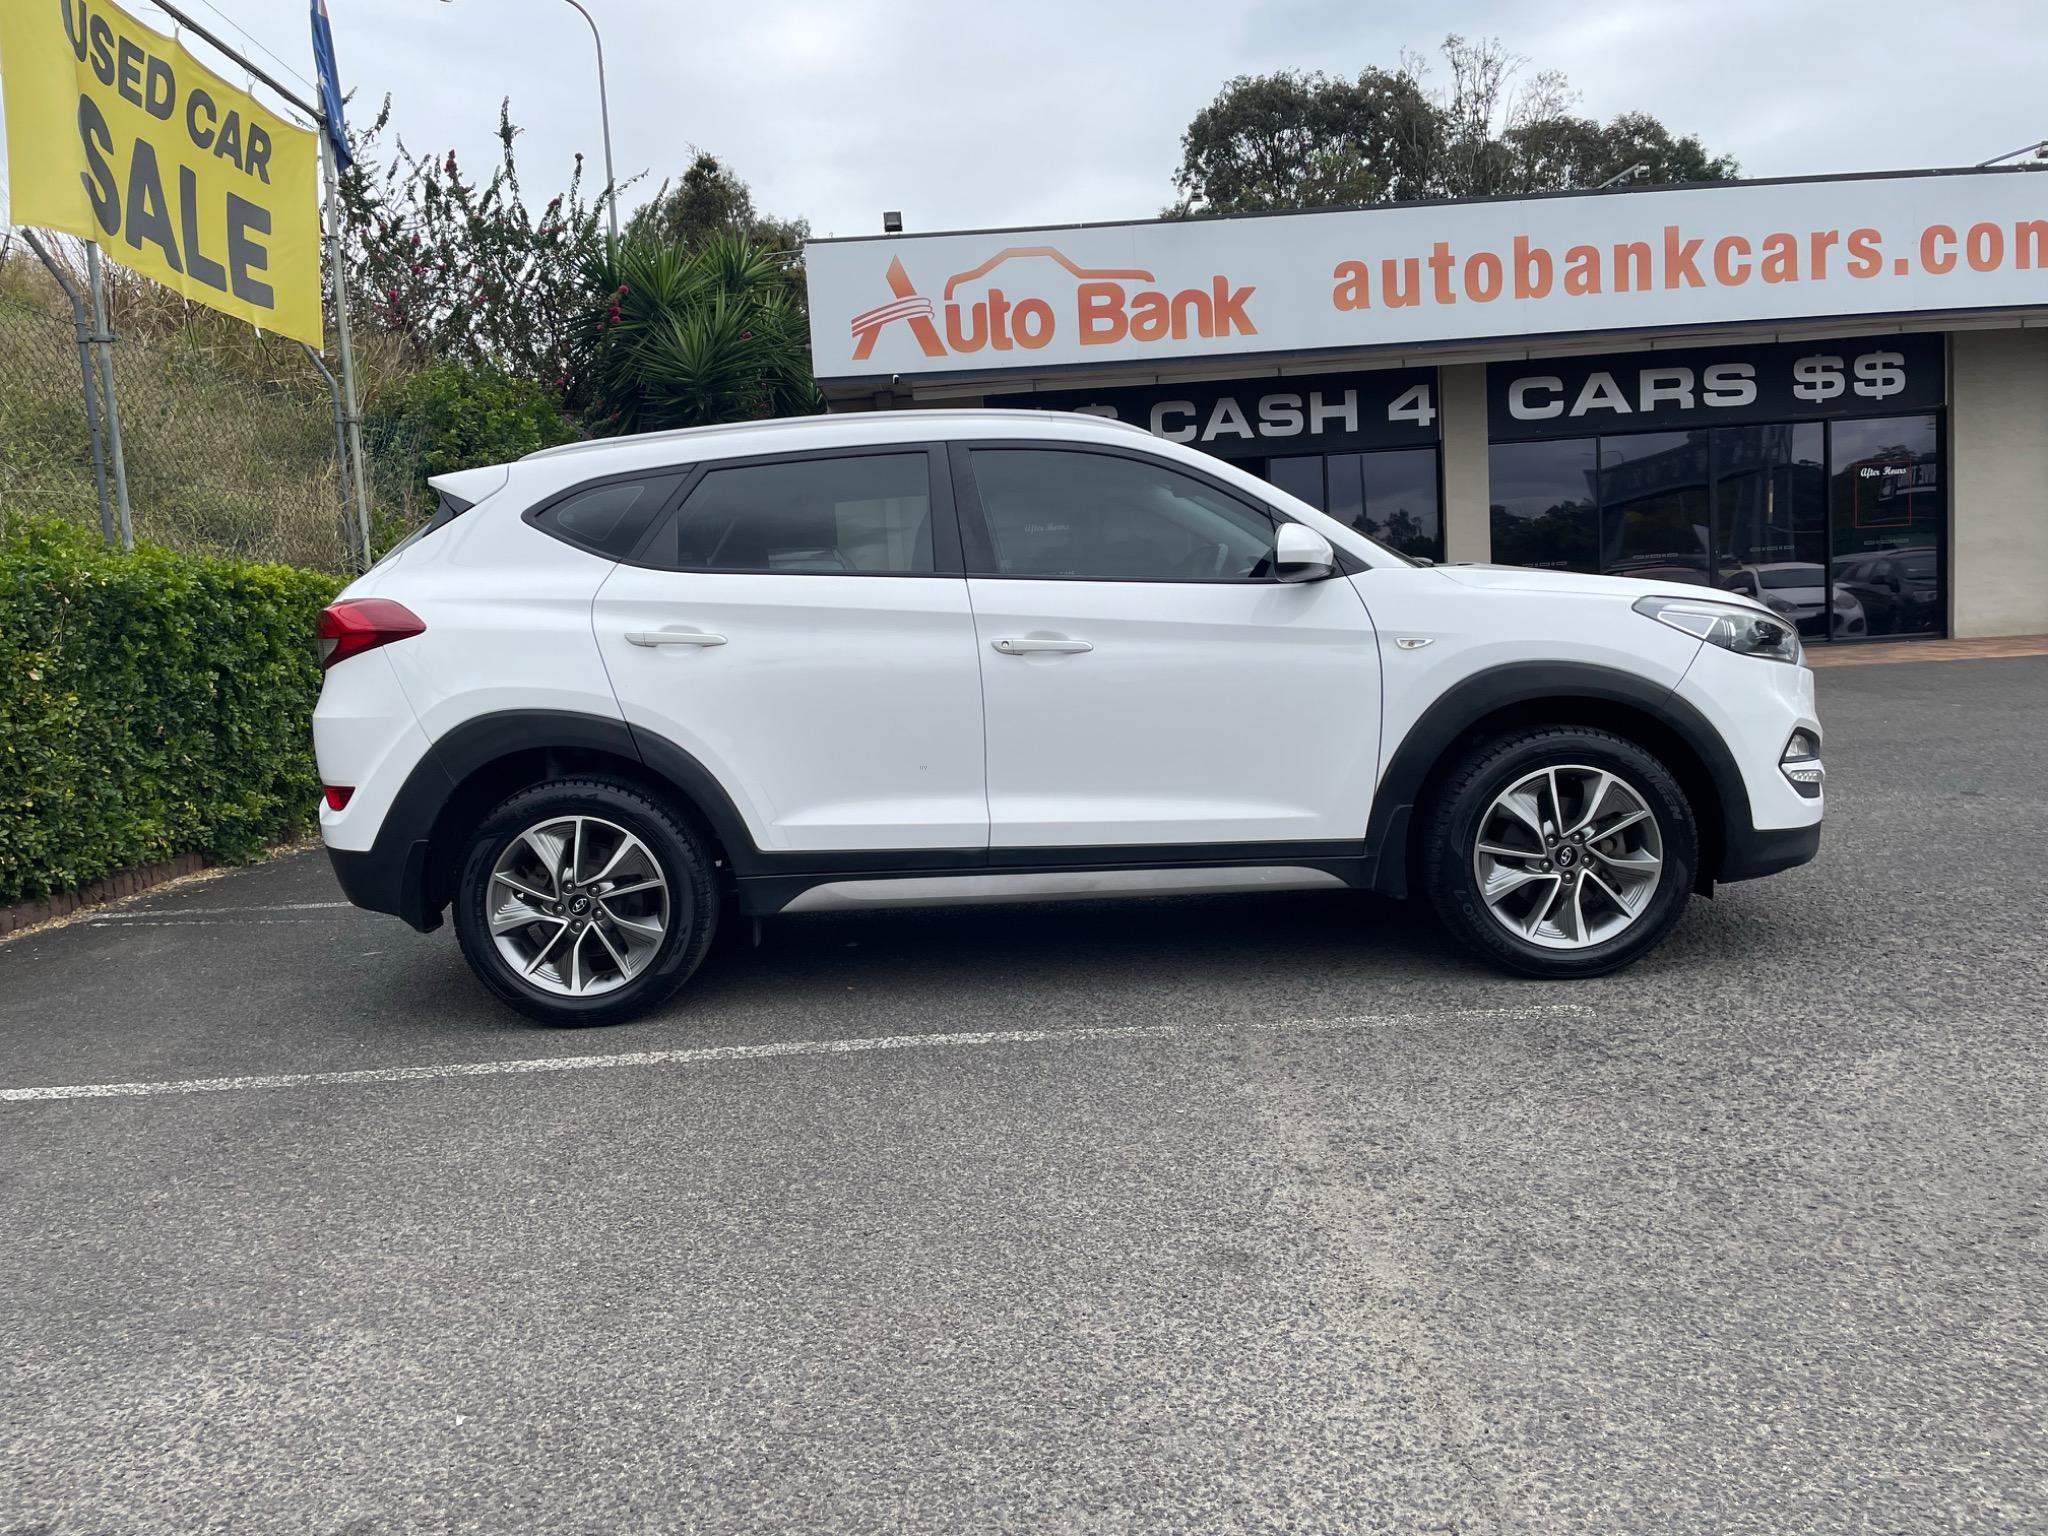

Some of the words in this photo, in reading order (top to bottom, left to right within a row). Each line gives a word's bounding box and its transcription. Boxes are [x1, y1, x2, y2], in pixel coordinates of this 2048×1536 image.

[60, 0, 176, 121] USED
[186, 88, 272, 185] CAR
[77, 93, 275, 310] SALE
[851, 254, 1056, 360] Auto
[1078, 275, 1258, 346] Bank
[1150, 389, 1358, 442] CASH
[1388, 385, 1436, 428] 4
[1508, 363, 1757, 421] CARS
[1860, 467, 1881, 479] After
[1882, 466, 1907, 477] Hours
